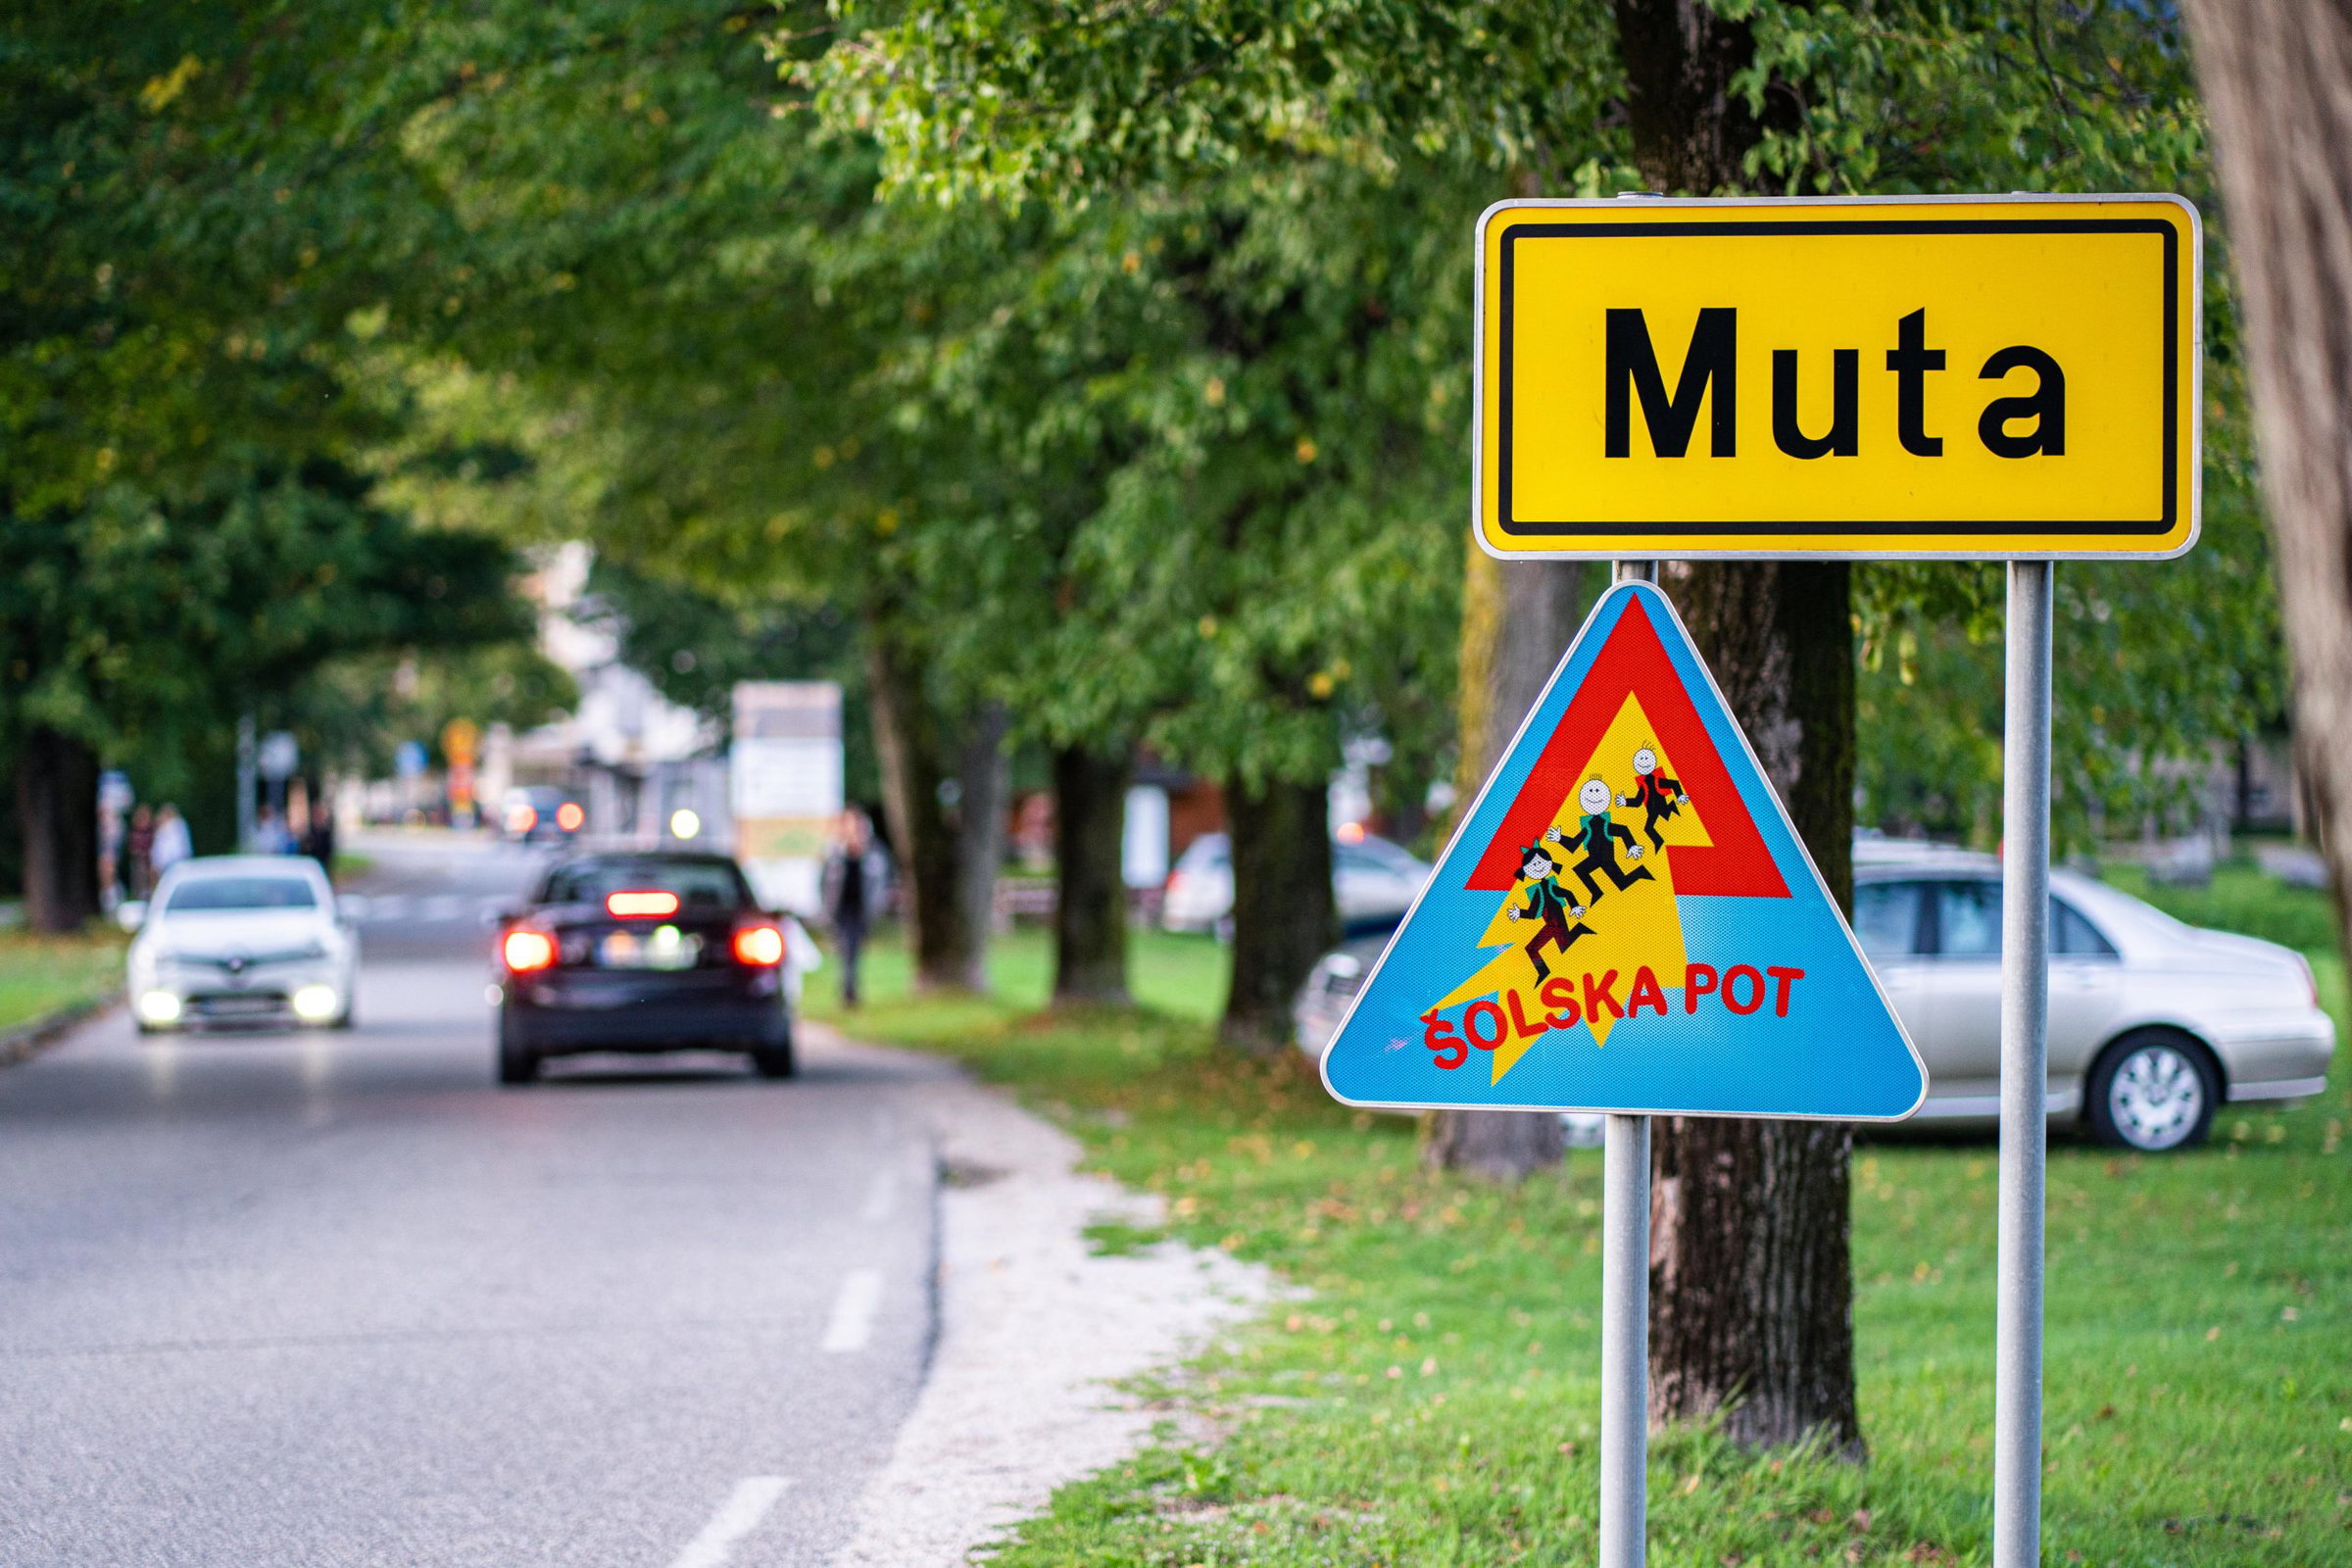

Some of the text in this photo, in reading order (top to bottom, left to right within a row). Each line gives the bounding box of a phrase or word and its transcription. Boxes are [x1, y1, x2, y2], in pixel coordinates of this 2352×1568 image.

[1604, 307, 2066, 460] Muta
[1420, 963, 1805, 1069] ŠOLSKA POT
